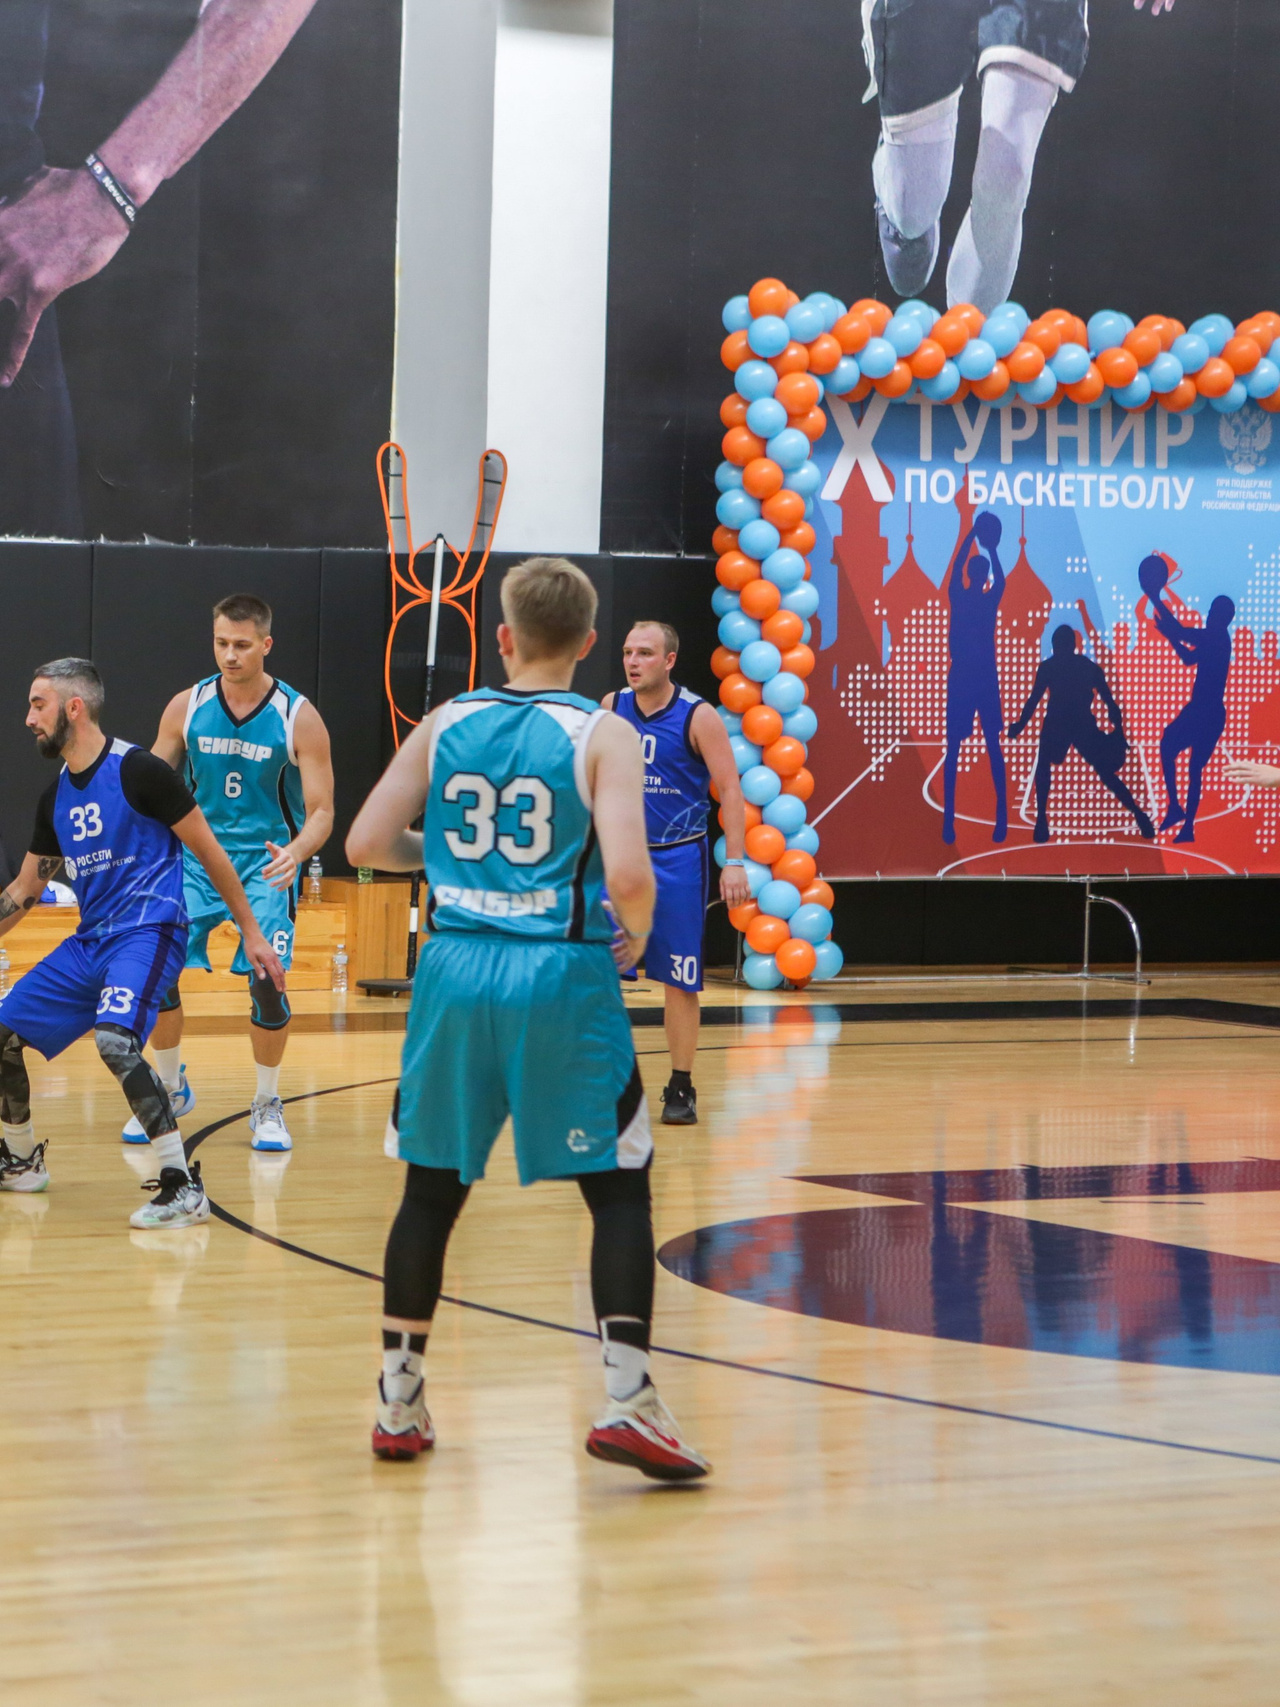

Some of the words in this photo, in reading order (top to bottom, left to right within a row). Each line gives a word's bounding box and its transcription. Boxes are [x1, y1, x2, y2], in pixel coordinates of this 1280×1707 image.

[102, 175, 127, 207] Never
[906, 392, 1195, 470] ТУРНИР
[904, 468, 956, 504] ПО
[967, 469, 1195, 511] БАСКЕТБОЛУ
[1216, 478, 1230, 487] ПРИ
[1216, 489, 1272, 500] ПРАВИТЕЛЬСТВА
[1201, 500, 1245, 511] РОССИЙСКОЙ
[197, 736, 273, 763] СИБУР
[224, 771, 242, 799] 6
[69, 802, 103, 842] 33
[442, 771, 555, 867] 33
[273, 930, 290, 956] 6
[670, 954, 697, 985] 30
[96, 986, 135, 1015] 33
